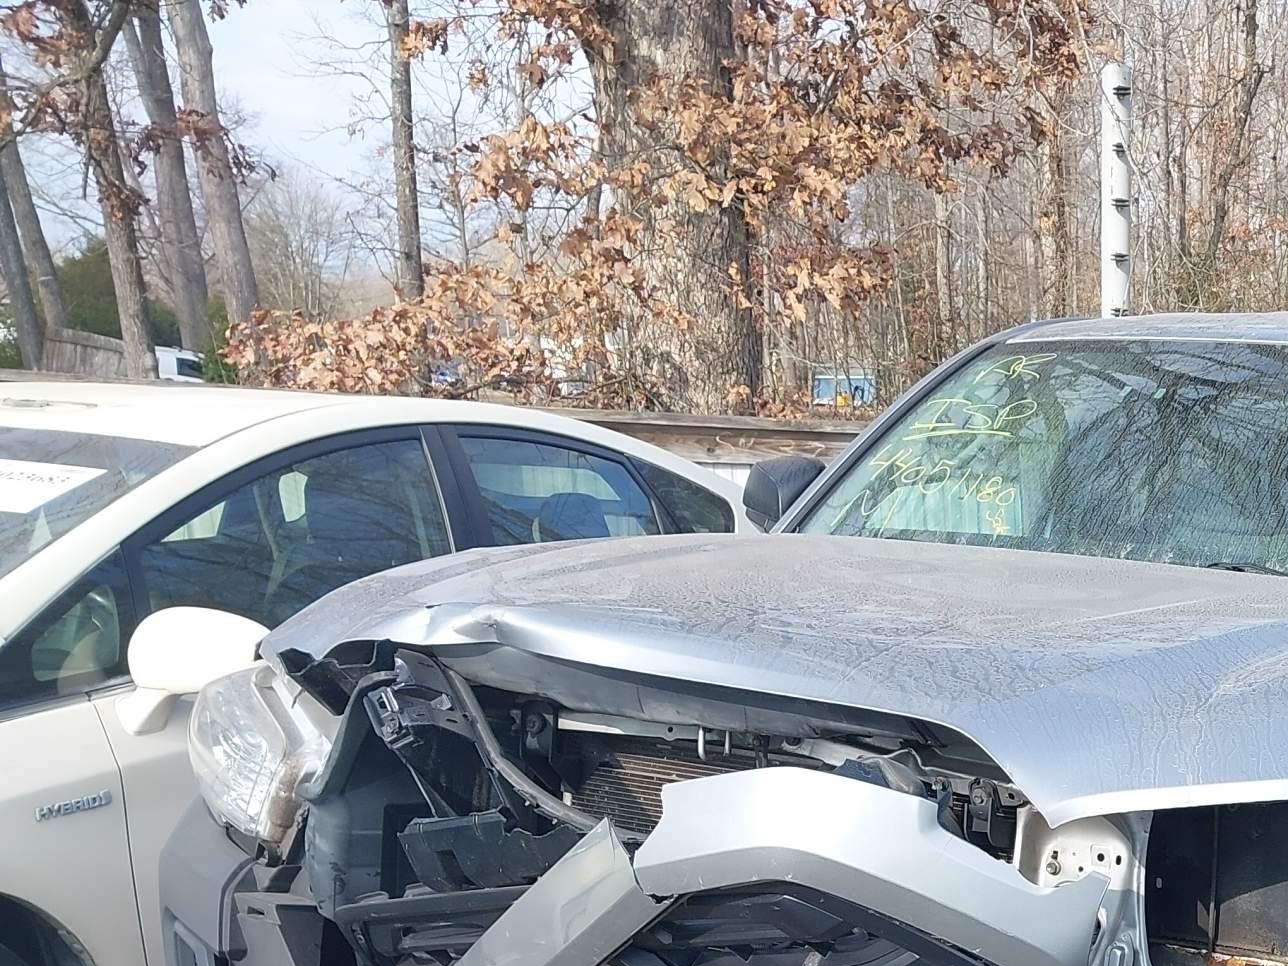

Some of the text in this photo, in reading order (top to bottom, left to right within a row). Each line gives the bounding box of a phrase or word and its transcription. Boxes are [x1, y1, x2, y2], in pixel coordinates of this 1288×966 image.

[909, 399, 1038, 431] ISP
[868, 445, 1016, 506] 44051180
[35, 793, 101, 822] HYBRID
